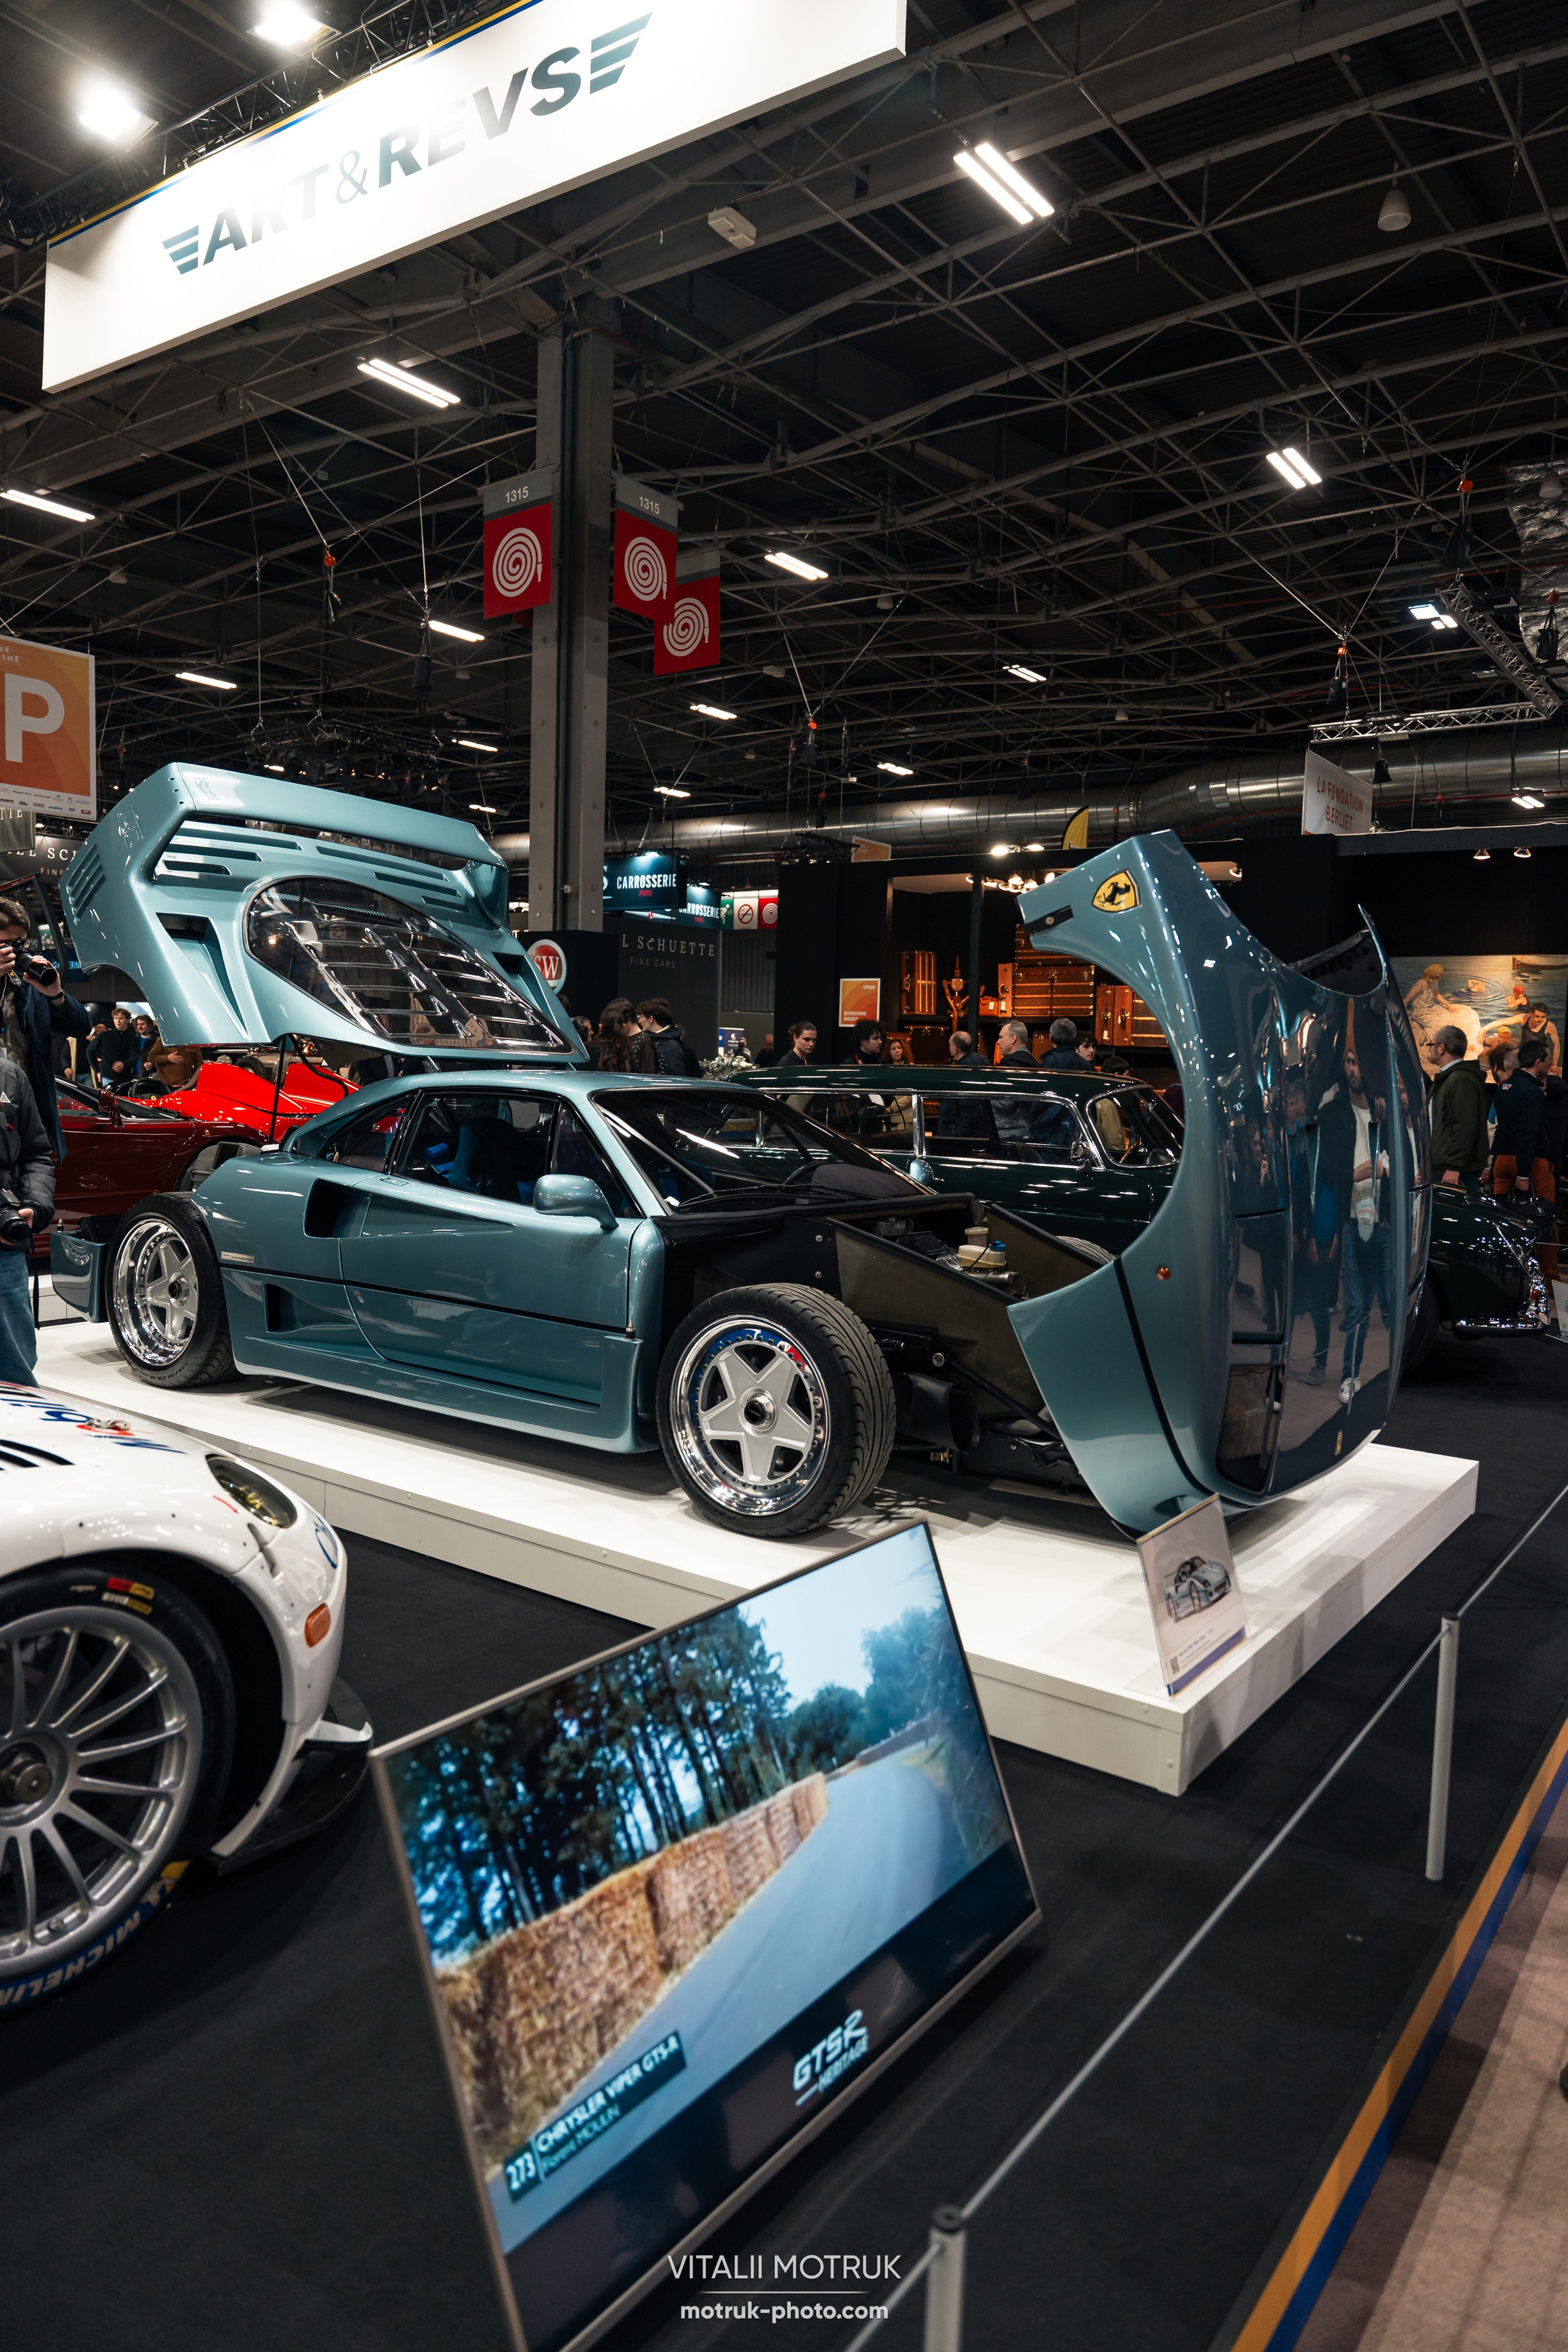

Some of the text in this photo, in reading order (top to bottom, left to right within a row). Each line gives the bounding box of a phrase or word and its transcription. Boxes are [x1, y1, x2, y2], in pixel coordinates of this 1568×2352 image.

[505, 486, 529, 503] 1315
[639, 496, 660, 515] 1315
[4, 673, 65, 763] P
[1317, 775, 1363, 815] LA FONDATION
[1325, 805, 1353, 832] BERLIET
[616, 873, 677, 889] CARROSSERIE
[637, 936, 715, 957] SCHUETTE
[630, 957, 675, 968] FINE CARS
[506, 2035, 679, 2191] 273 CHRYSLER VIPER GTS-R
